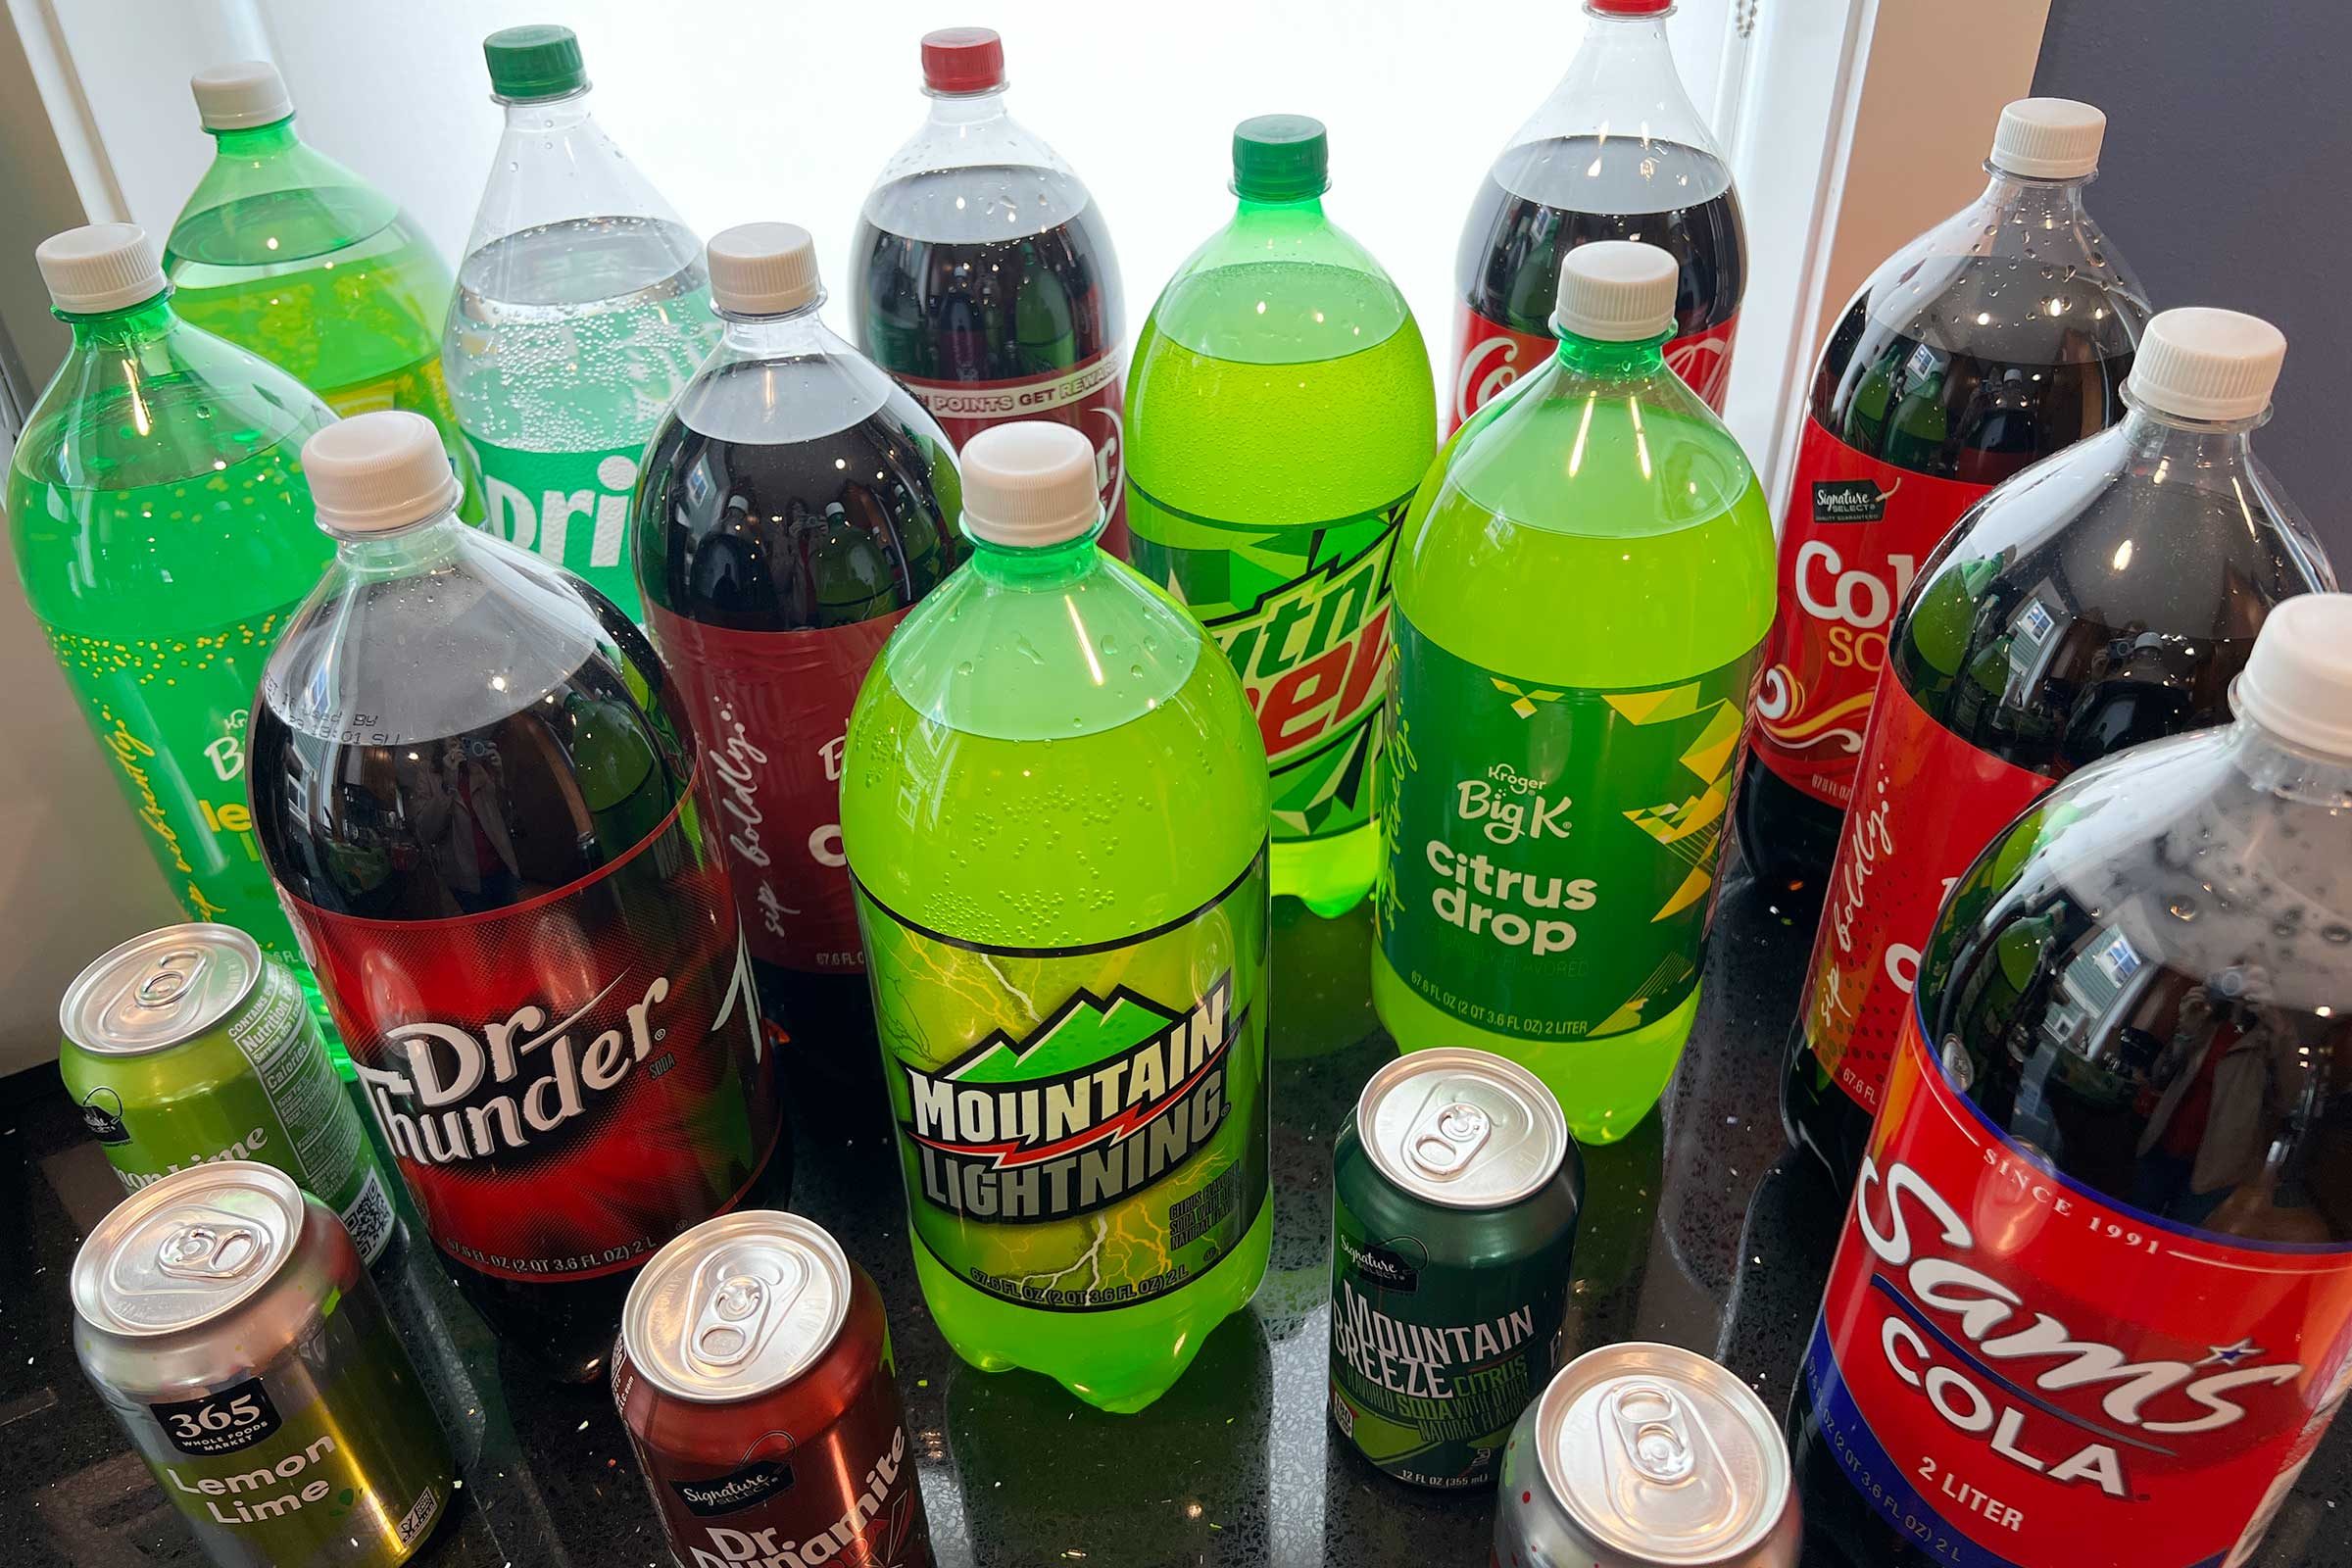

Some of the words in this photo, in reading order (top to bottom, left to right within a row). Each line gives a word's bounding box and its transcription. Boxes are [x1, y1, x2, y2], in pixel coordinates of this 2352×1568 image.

[935, 395, 1014, 413] POINTS
[1019, 388, 1055, 407] GET
[1059, 358, 1119, 399] REWAR
[485, 455, 638, 567] pri
[1817, 489, 1869, 512] Signature
[1832, 504, 1869, 513] SELECT
[1795, 540, 1914, 629] Col
[1829, 626, 1888, 671] SO
[1488, 762, 1546, 794] Kroger
[1426, 840, 1597, 911] citrus
[186, 882, 226, 922] ip
[1431, 885, 1577, 956] drop
[228, 996, 268, 1038] CONTAINS
[1411, 970, 1429, 993] 67.6
[1430, 984, 1442, 1001] FL
[1443, 992, 1457, 1009] OZ
[1457, 1000, 1468, 1015] (2
[1470, 1005, 1486, 1020] QT
[1487, 1011, 1505, 1027] 3.6
[1507, 1015, 1520, 1030] FL
[1523, 1019, 1544, 1035] OZ)
[1544, 1022, 1553, 1034] 2
[1555, 1020, 1588, 1035] LITER
[242, 1001, 290, 1053] Nutrition
[266, 1041, 308, 1090] Calories
[356, 977, 669, 1166] Thunder
[385, 1005, 547, 1107] Dr
[650, 1053, 675, 1080] SODA
[906, 983, 1226, 1146] MOUNTAIN
[1842, 1067, 1864, 1094] 67.6
[1864, 1087, 1876, 1104] FL
[919, 1069, 1223, 1217] LIGHTNING
[1170, 1190, 1202, 1221] CITRUS
[1981, 1148, 2073, 1218] SINCE
[2088, 1215, 2161, 1255] 1991
[472, 1249, 489, 1264] FL
[491, 1254, 511, 1269] OZ
[530, 1258, 549, 1273] QT
[555, 1257, 577, 1272] 3.6
[582, 1254, 601, 1269] FL
[605, 1245, 630, 1262] OZ)
[634, 1240, 645, 1254] 2
[646, 1236, 657, 1249] L
[1341, 1234, 1397, 1273] Signature
[970, 1267, 1001, 1291] 67.6
[1003, 1280, 1020, 1298] FL
[1023, 1288, 1043, 1302] OZ
[1047, 1289, 1063, 1305] (2
[1066, 1291, 1088, 1305] QT
[1090, 1289, 1114, 1303] 3.6
[1116, 1285, 1137, 1300] FL
[1138, 1277, 1164, 1295] OZ)
[1166, 1271, 1177, 1286] 2
[1179, 1264, 1190, 1279] L
[1343, 1278, 1534, 1366] MOUNTAIN
[1332, 1296, 1455, 1398] BREEZE
[1453, 1356, 1528, 1398] CITRUS
[169, 1394, 261, 1438] 365
[1396, 1395, 1453, 1421] SODA
[1452, 1393, 1489, 1419] WITH
[1420, 1412, 1482, 1444] NATURAL
[1881, 1315, 2127, 1498] COLA
[182, 1436, 223, 1447] WHOLE
[228, 1421, 269, 1440] FOODS
[204, 1435, 253, 1451] MARKET
[167, 1435, 335, 1494] Lemon
[1402, 1469, 1413, 1481] 12
[1415, 1471, 1427, 1483] FL
[1429, 1475, 1444, 1486] OZ
[1446, 1476, 1469, 1488] (355
[1823, 1408, 1836, 1434] OZ
[1834, 1431, 1845, 1451] (2
[1845, 1449, 1861, 1472] QT
[1861, 1471, 1882, 1498] 3.6
[1884, 1494, 1900, 1519] FL
[1904, 1515, 1933, 1543] OZ)
[1936, 1538, 1949, 1553] 2
[1951, 1546, 1961, 1562] L
[206, 1480, 330, 1524] Lime
[683, 1472, 770, 1506] Signature
[716, 1481, 772, 1505] SELECT
[1918, 1456, 1937, 1481] 2
[1941, 1469, 2025, 1532] LITER
[706, 1527, 796, 1561] Dr.
